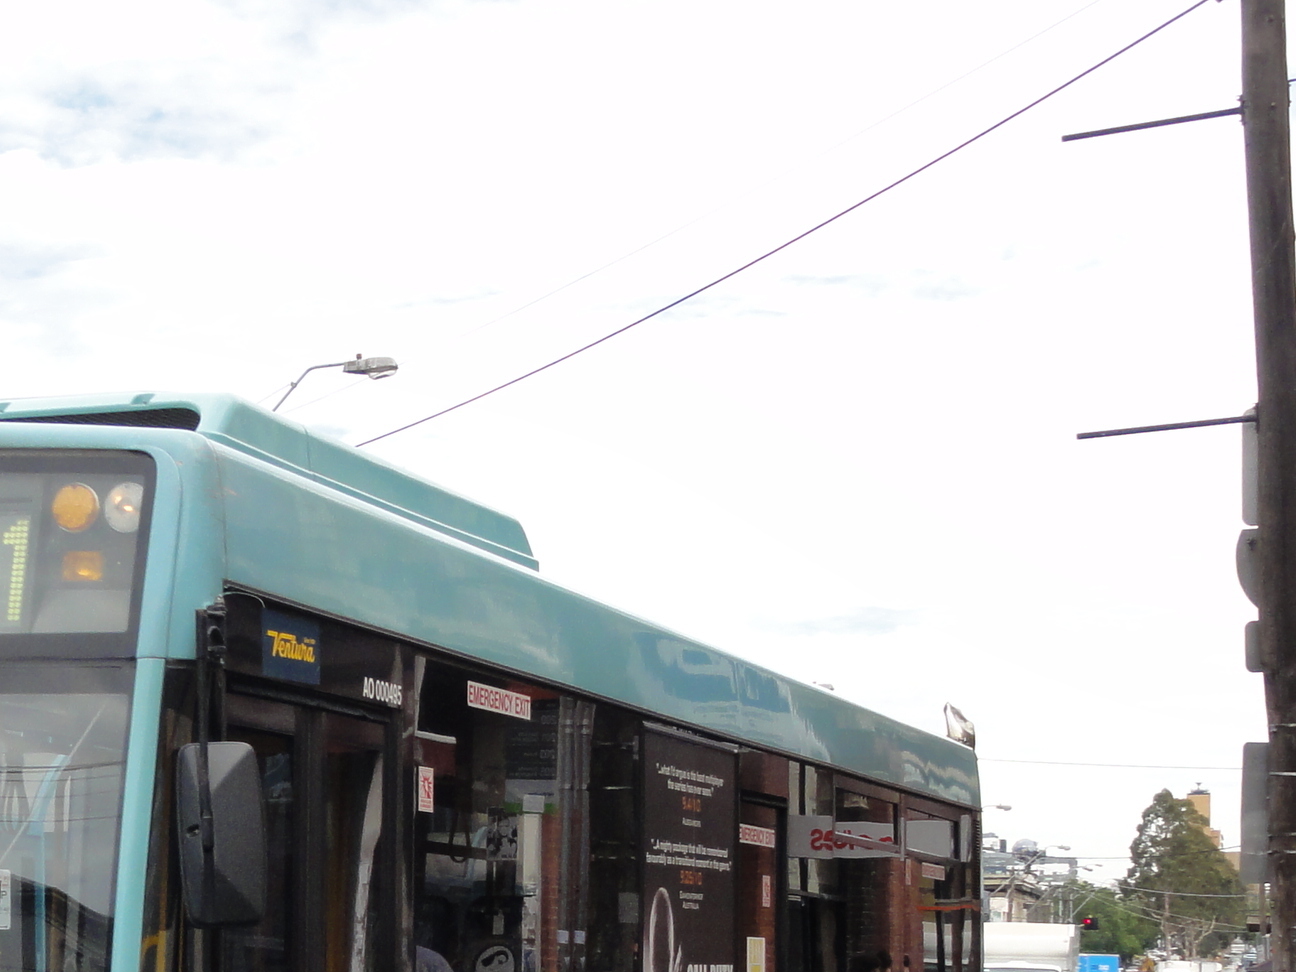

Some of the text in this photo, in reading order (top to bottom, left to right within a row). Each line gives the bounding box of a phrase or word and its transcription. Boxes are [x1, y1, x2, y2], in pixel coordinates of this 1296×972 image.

[266, 629, 316, 663] Ventura
[363, 676, 403, 706] AO 000495
[468, 684, 531, 718] EMERGENCY EXIT
